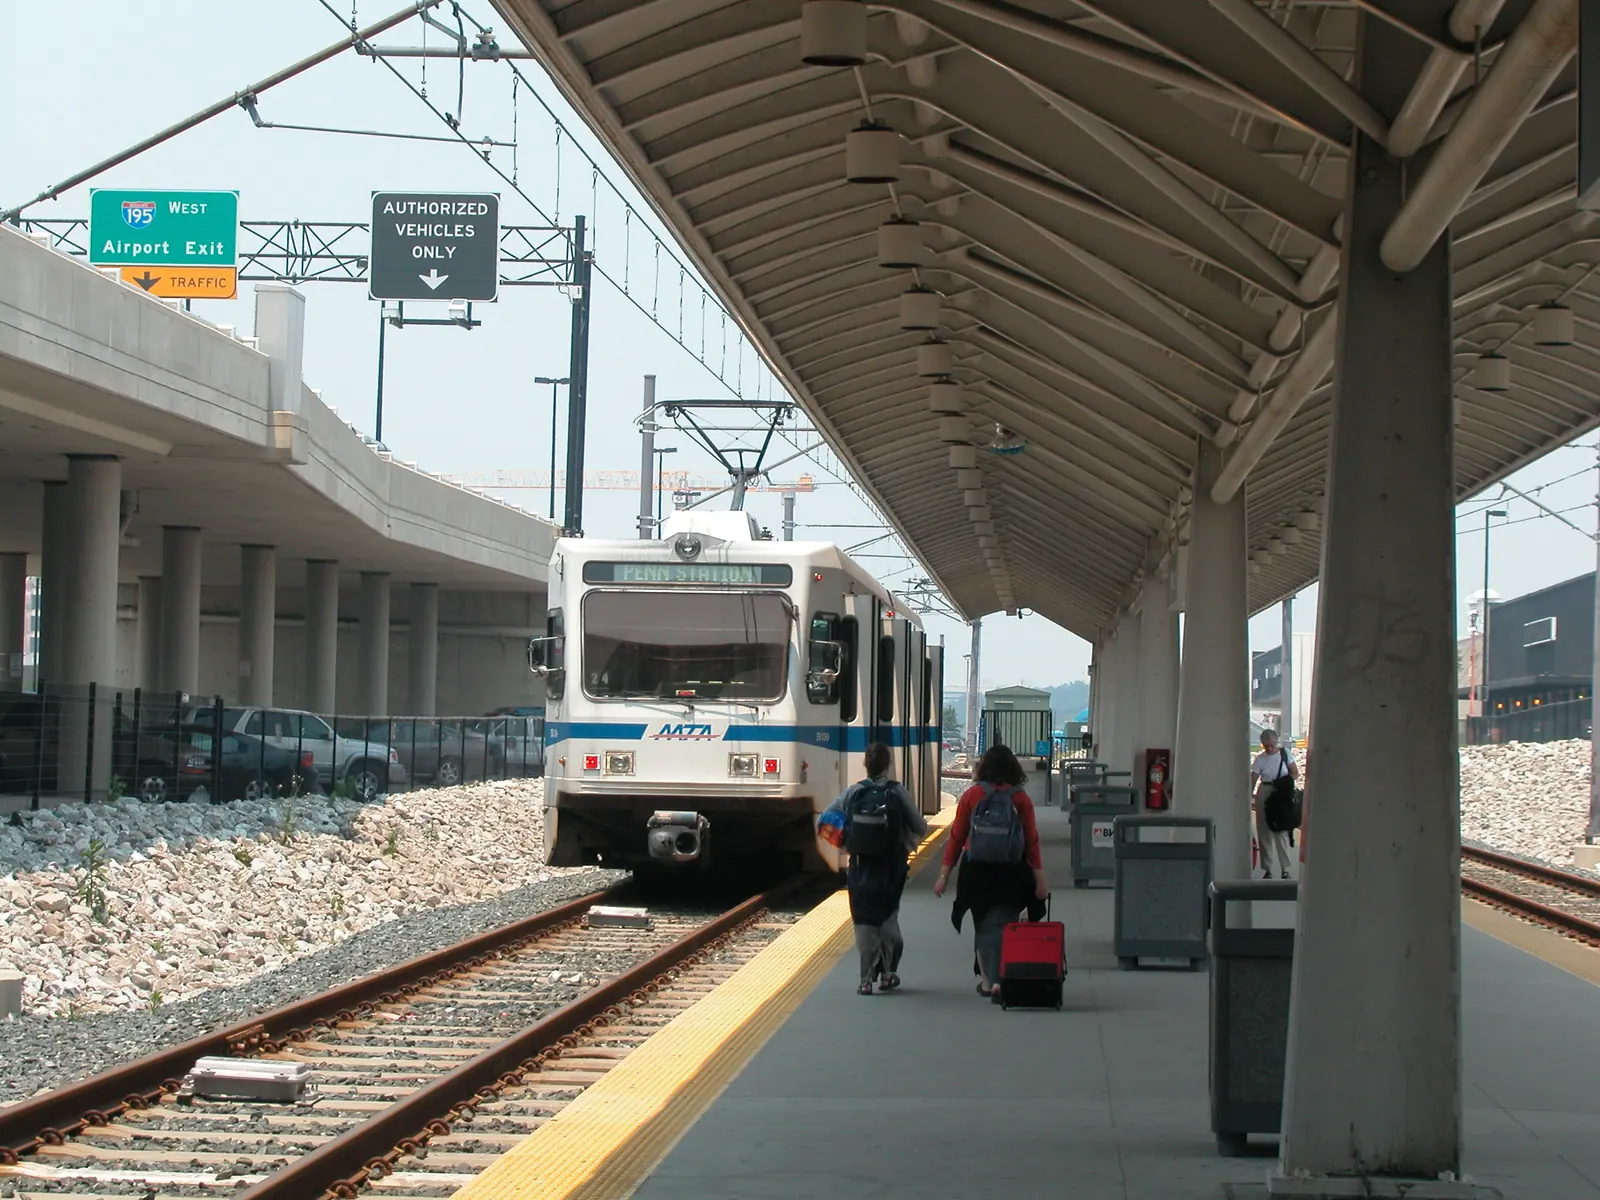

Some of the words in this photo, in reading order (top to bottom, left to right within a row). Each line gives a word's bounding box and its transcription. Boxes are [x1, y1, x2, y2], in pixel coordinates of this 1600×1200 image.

[127, 208, 153, 224] 195
[168, 201, 208, 214] WEST
[383, 201, 489, 216] AUTHORIZED
[395, 223, 475, 237] VEHICLES
[102, 239, 170, 257] Airport
[185, 240, 224, 255] Exit
[412, 245, 457, 259] ONLY
[169, 277, 227, 288] TRAFFIC
[623, 565, 670, 581] PENN
[676, 566, 754, 583] STATION
[654, 723, 712, 741] MTA
